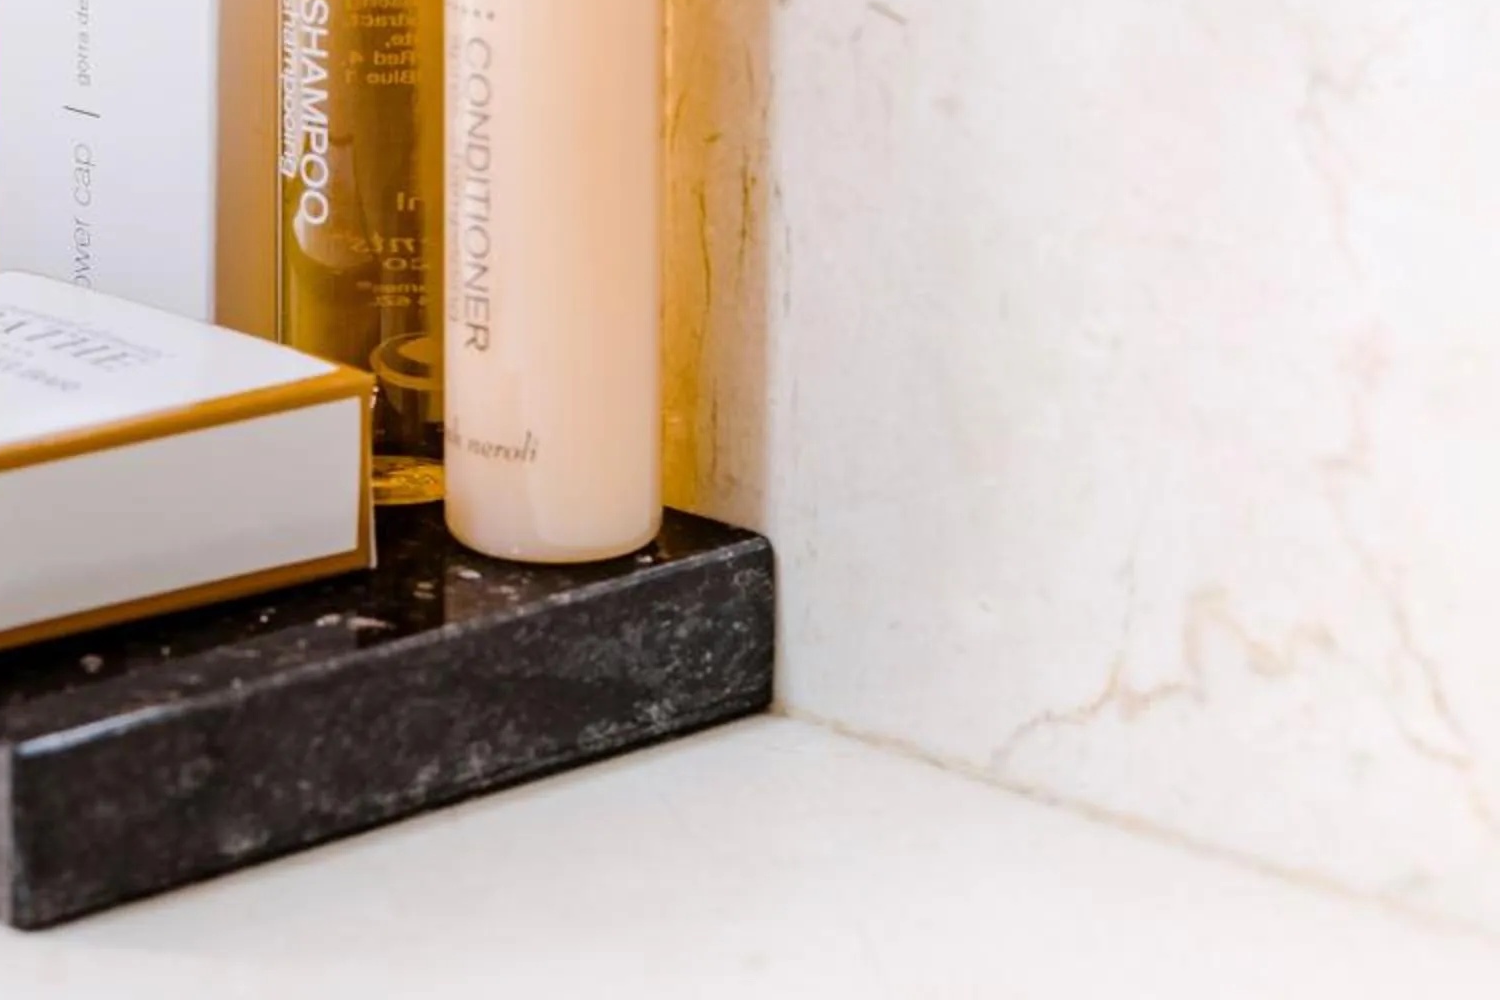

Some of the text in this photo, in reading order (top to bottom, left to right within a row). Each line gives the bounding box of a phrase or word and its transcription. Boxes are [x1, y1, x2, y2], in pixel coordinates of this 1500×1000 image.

[73, 143, 97, 207] cap
[463, 36, 493, 353] CONDITIONER
[73, 216, 92, 288] ower
